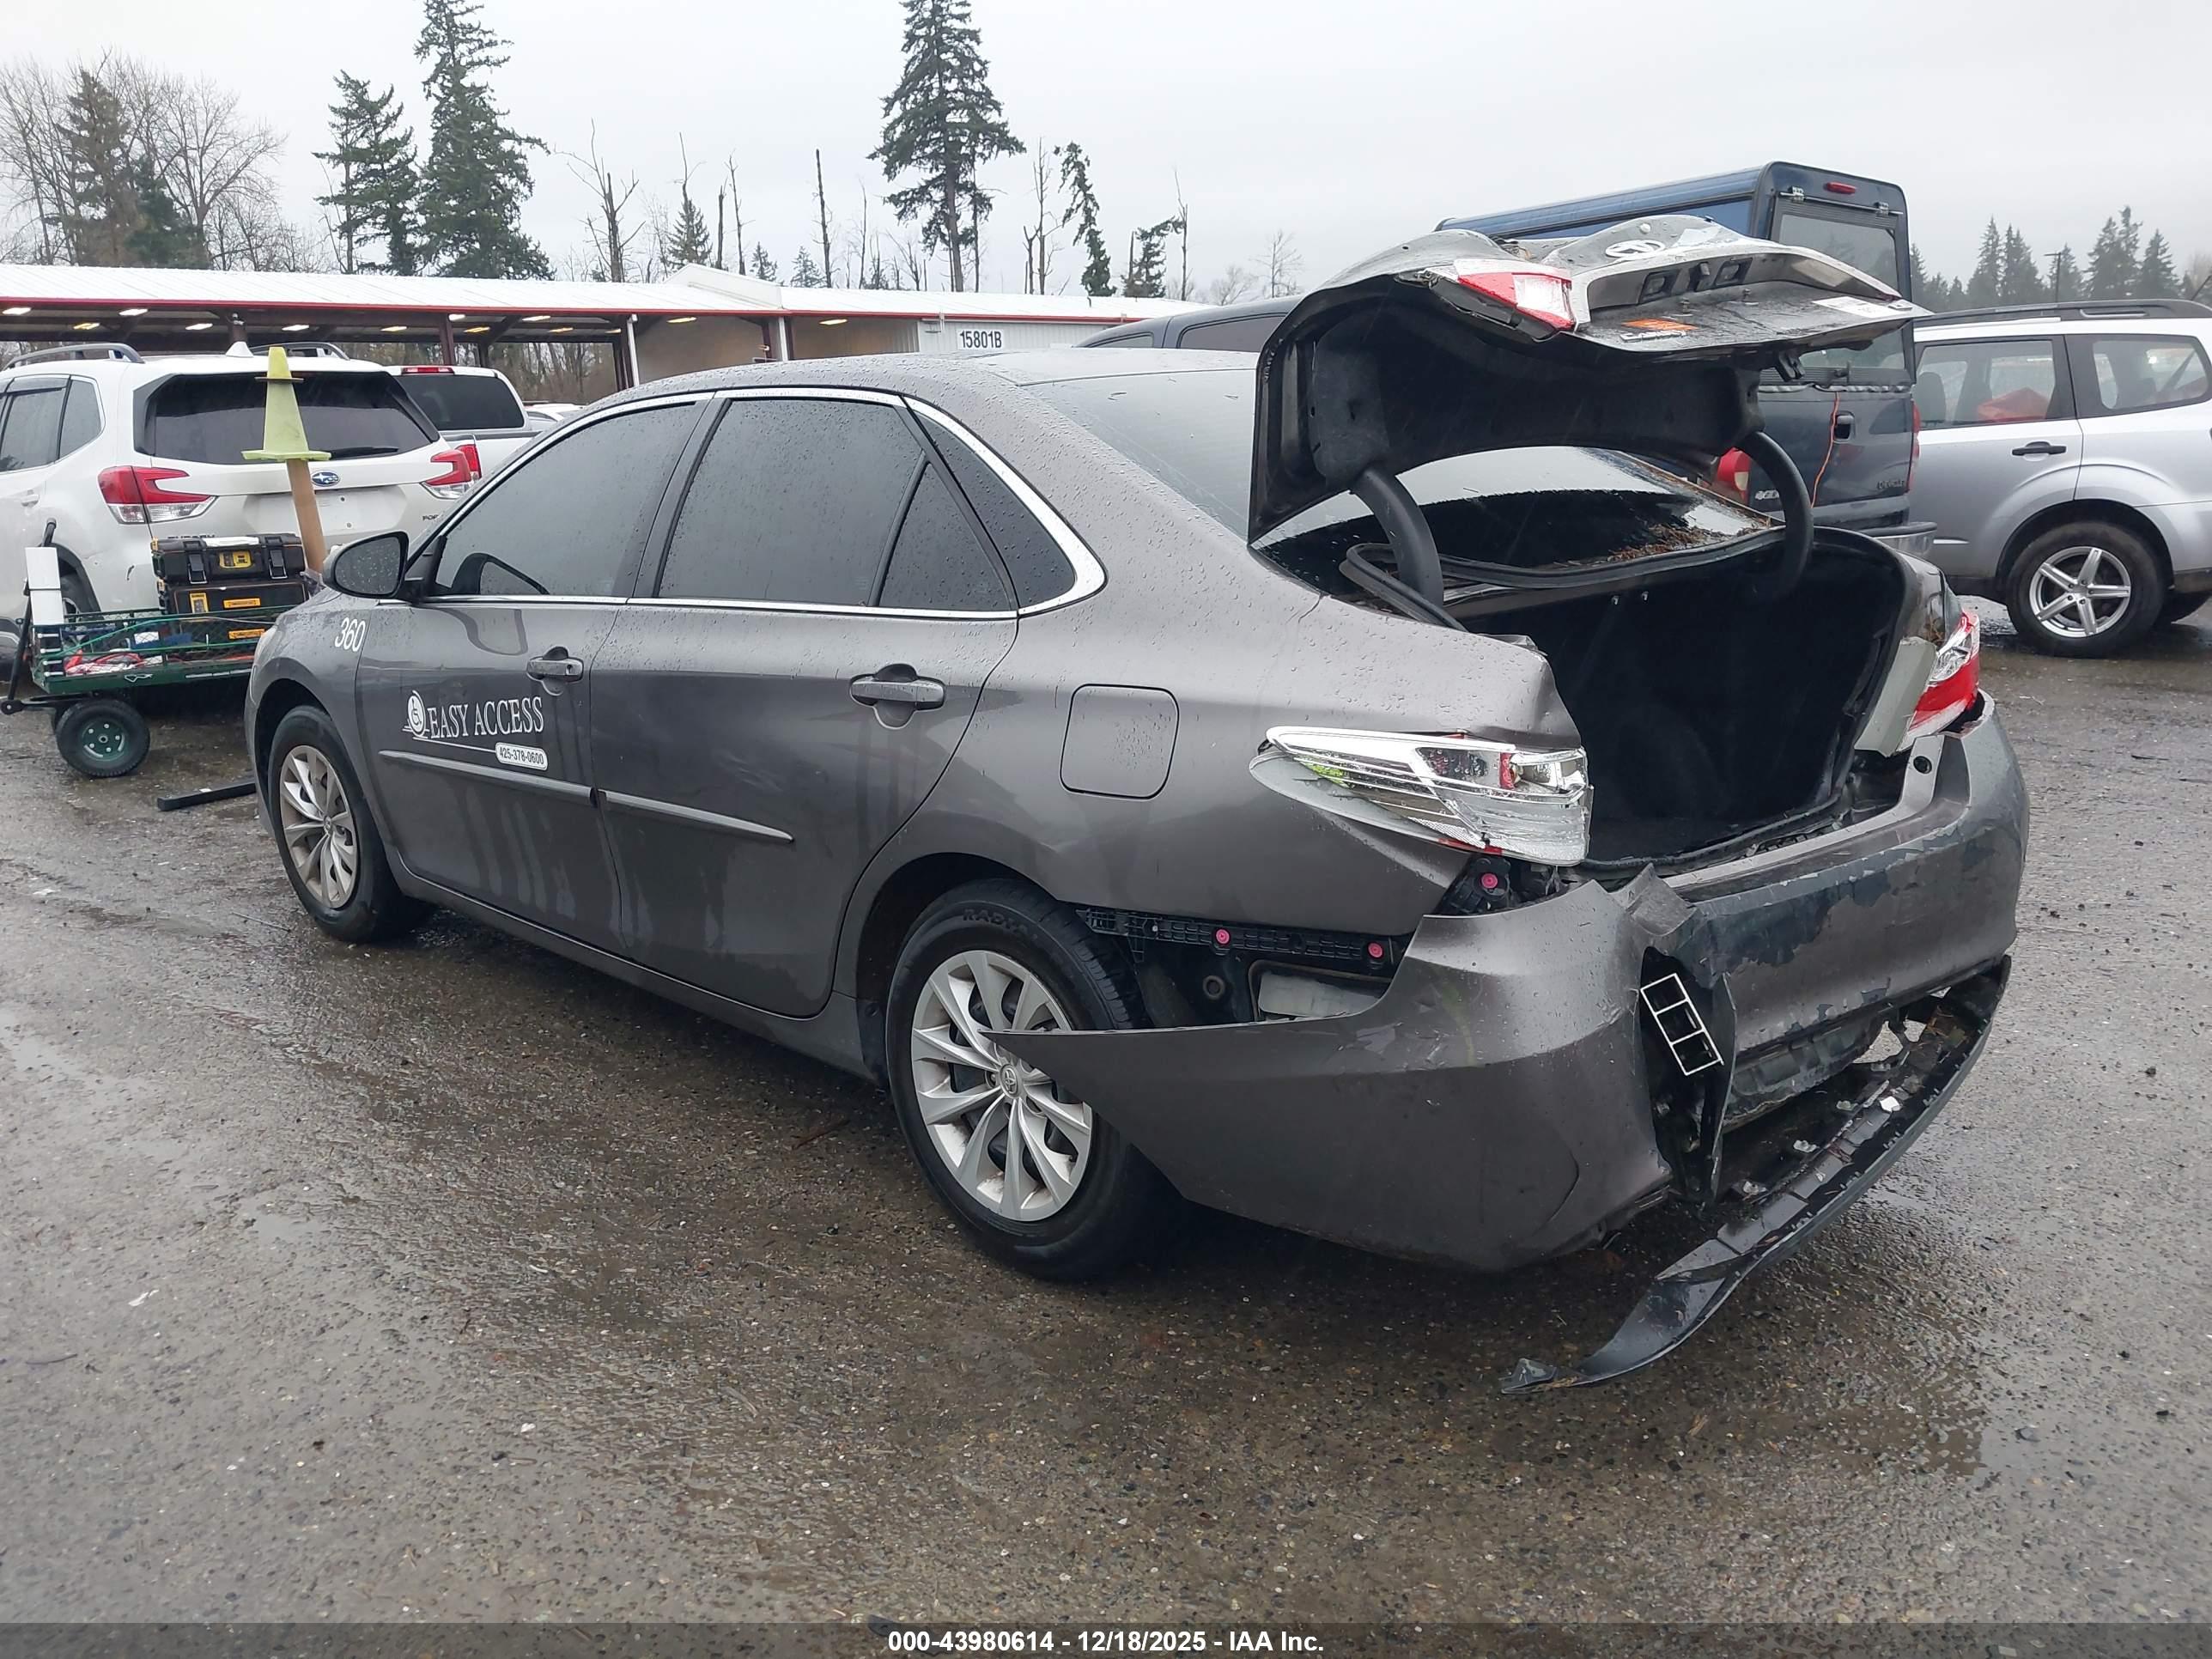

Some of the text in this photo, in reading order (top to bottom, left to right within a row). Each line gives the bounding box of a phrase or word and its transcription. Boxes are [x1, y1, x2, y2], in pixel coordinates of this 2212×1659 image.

[959, 330, 1002, 349] 15801B
[334, 617, 366, 652] 360
[427, 696, 544, 738] EASY ACCESS
[499, 746, 544, 765] 425-378-0600
